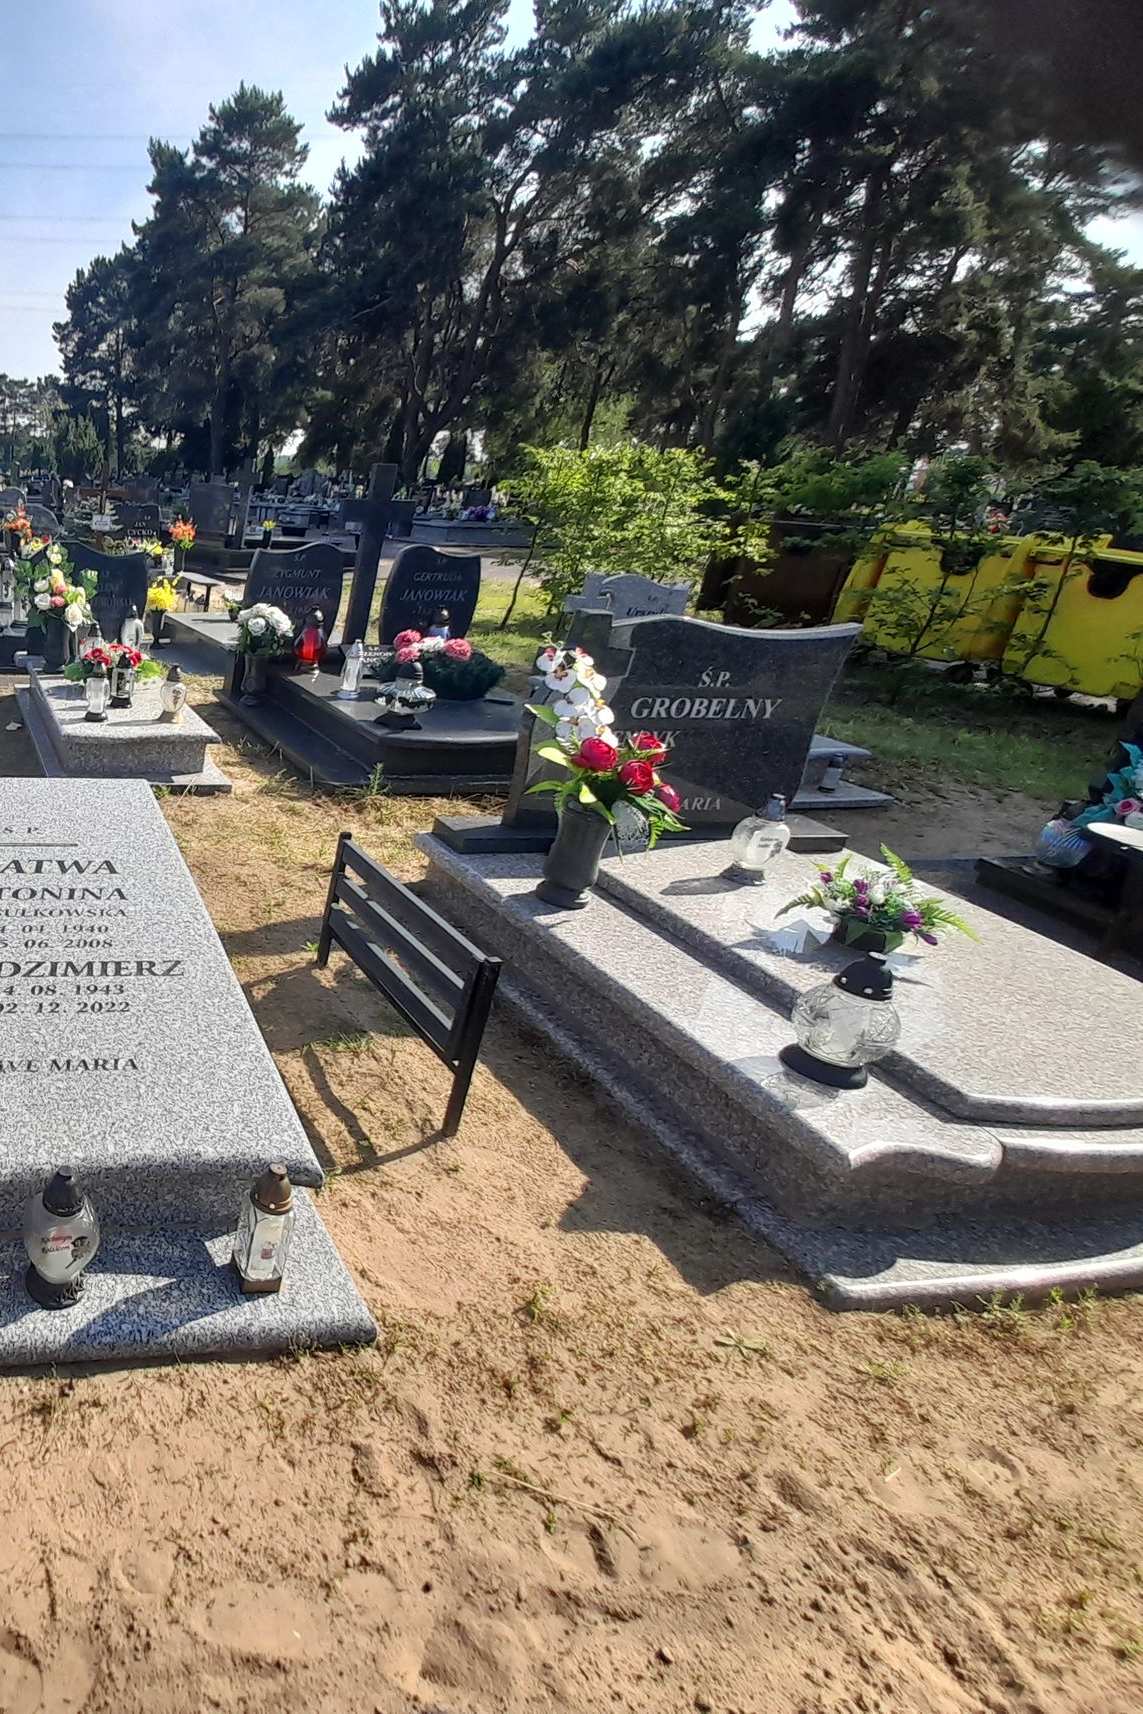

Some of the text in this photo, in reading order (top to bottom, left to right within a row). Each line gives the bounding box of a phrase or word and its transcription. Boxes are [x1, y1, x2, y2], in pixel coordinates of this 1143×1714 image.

[273, 569, 322, 579] ZYGMUNT
[258, 585, 331, 601] JANOWIAK
[400, 588, 469, 602] JANOWIAK
[630, 697, 784, 720] GROBELNY
[680, 797, 722, 811] ARIA
[63, 938, 114, 949] 2008
[75, 983, 126, 996] 1943
[77, 1001, 131, 1014] 2022
[49, 1057, 139, 1072] MARIA
